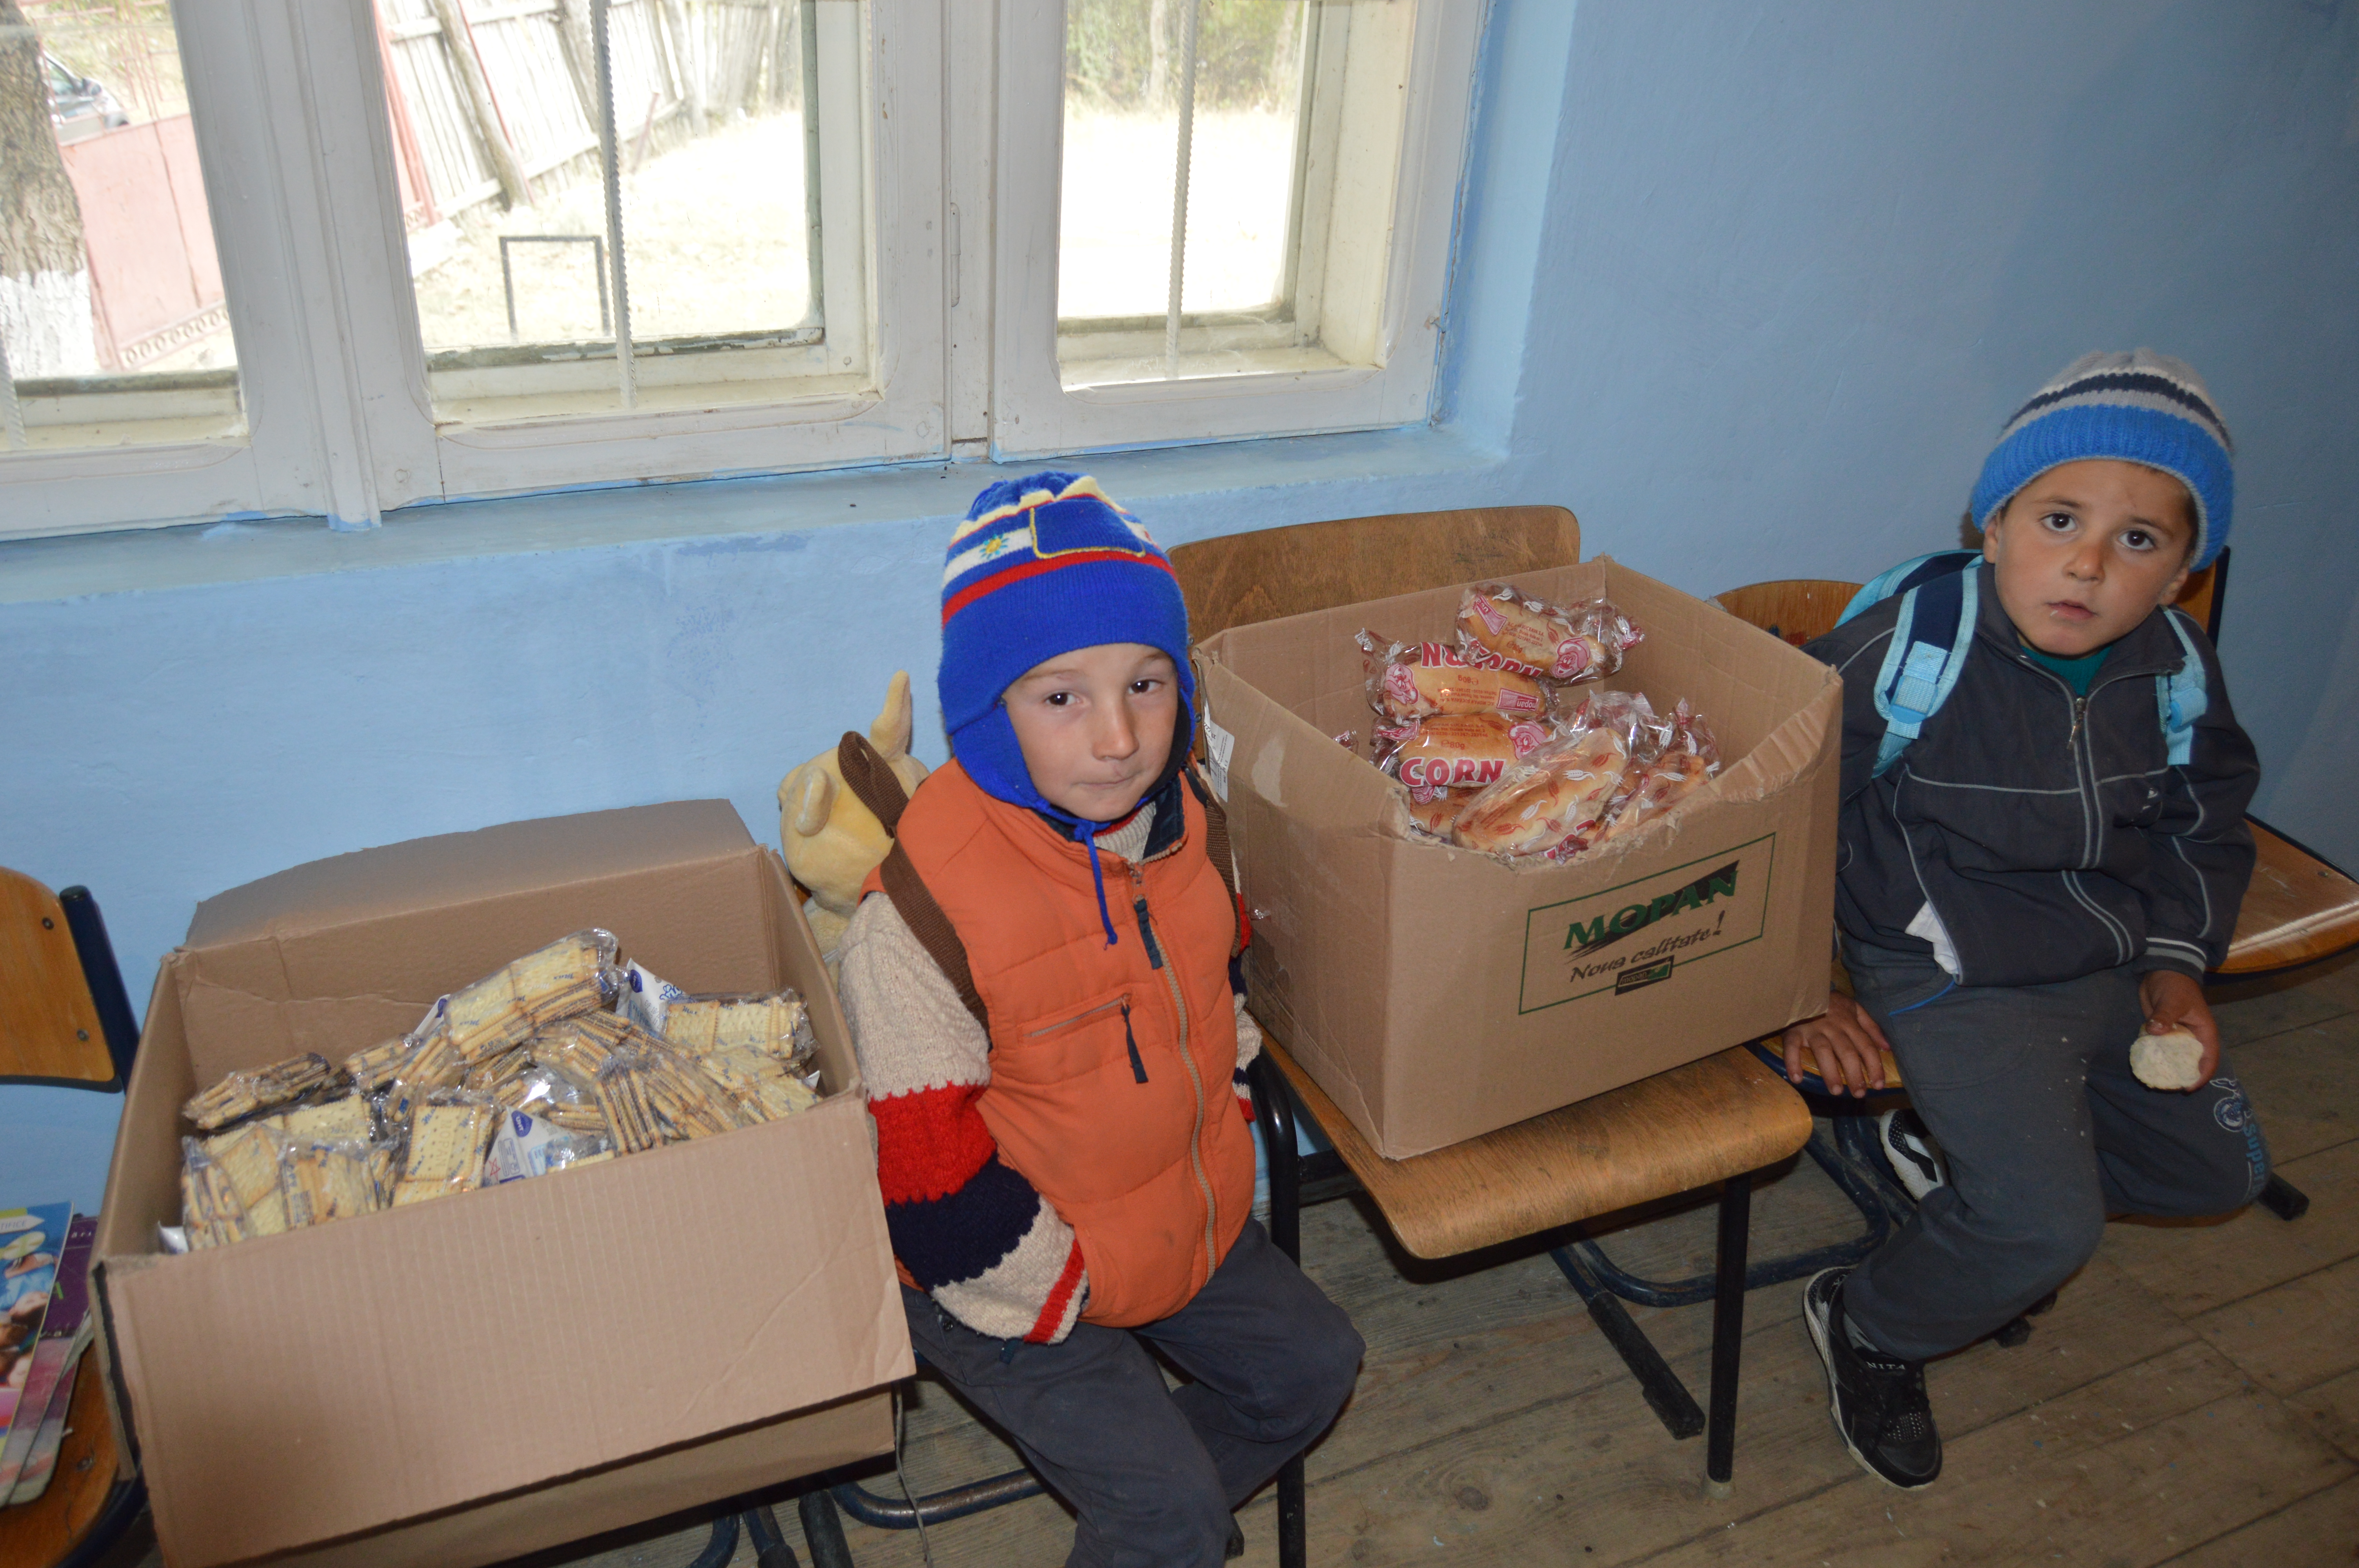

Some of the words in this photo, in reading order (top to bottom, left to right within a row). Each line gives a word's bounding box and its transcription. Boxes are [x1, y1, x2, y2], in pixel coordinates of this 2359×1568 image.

[1399, 757, 1507, 787] CORN
[1564, 870, 1738, 949] MOPAN
[682, 1006, 697, 1014] Max
[515, 1116, 524, 1131] UHT
[1866, 1361, 1906, 1370] NITA
